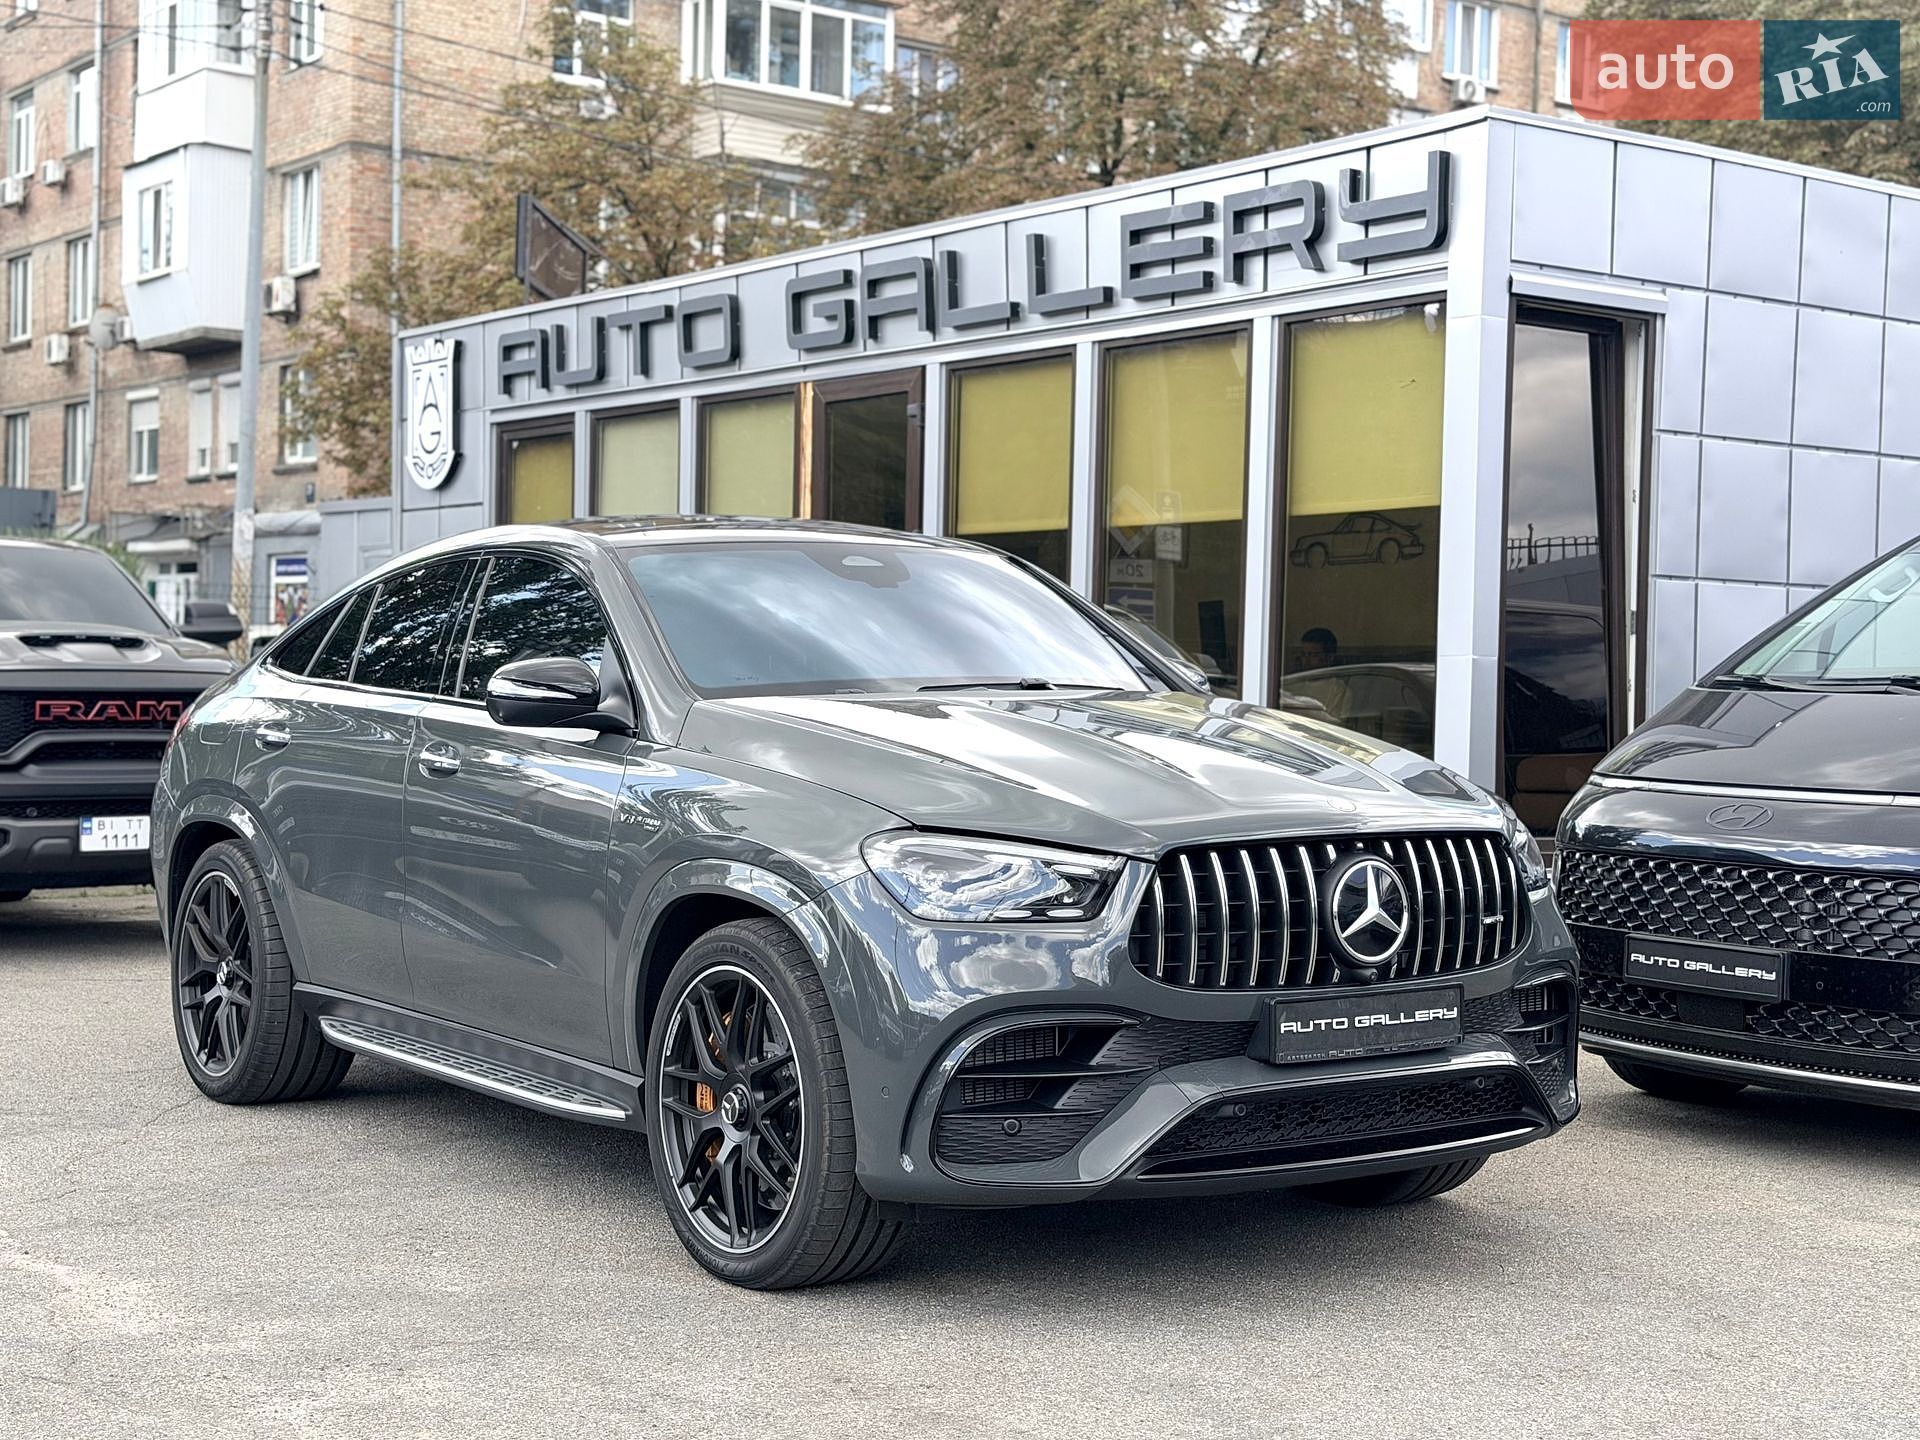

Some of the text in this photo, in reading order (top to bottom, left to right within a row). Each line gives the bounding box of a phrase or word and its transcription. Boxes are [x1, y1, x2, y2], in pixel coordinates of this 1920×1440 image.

[498, 149, 1451, 399] AUTO GALLERY
[35, 700, 183, 721] RAM
[126, 818, 145, 831] TT
[101, 832, 139, 849] 1111
[1630, 952, 1776, 981] AUTO GALLERY
[1280, 1006, 1458, 1034] AUTO GALLERY
[1328, 1047, 1364, 1058] AUTO
